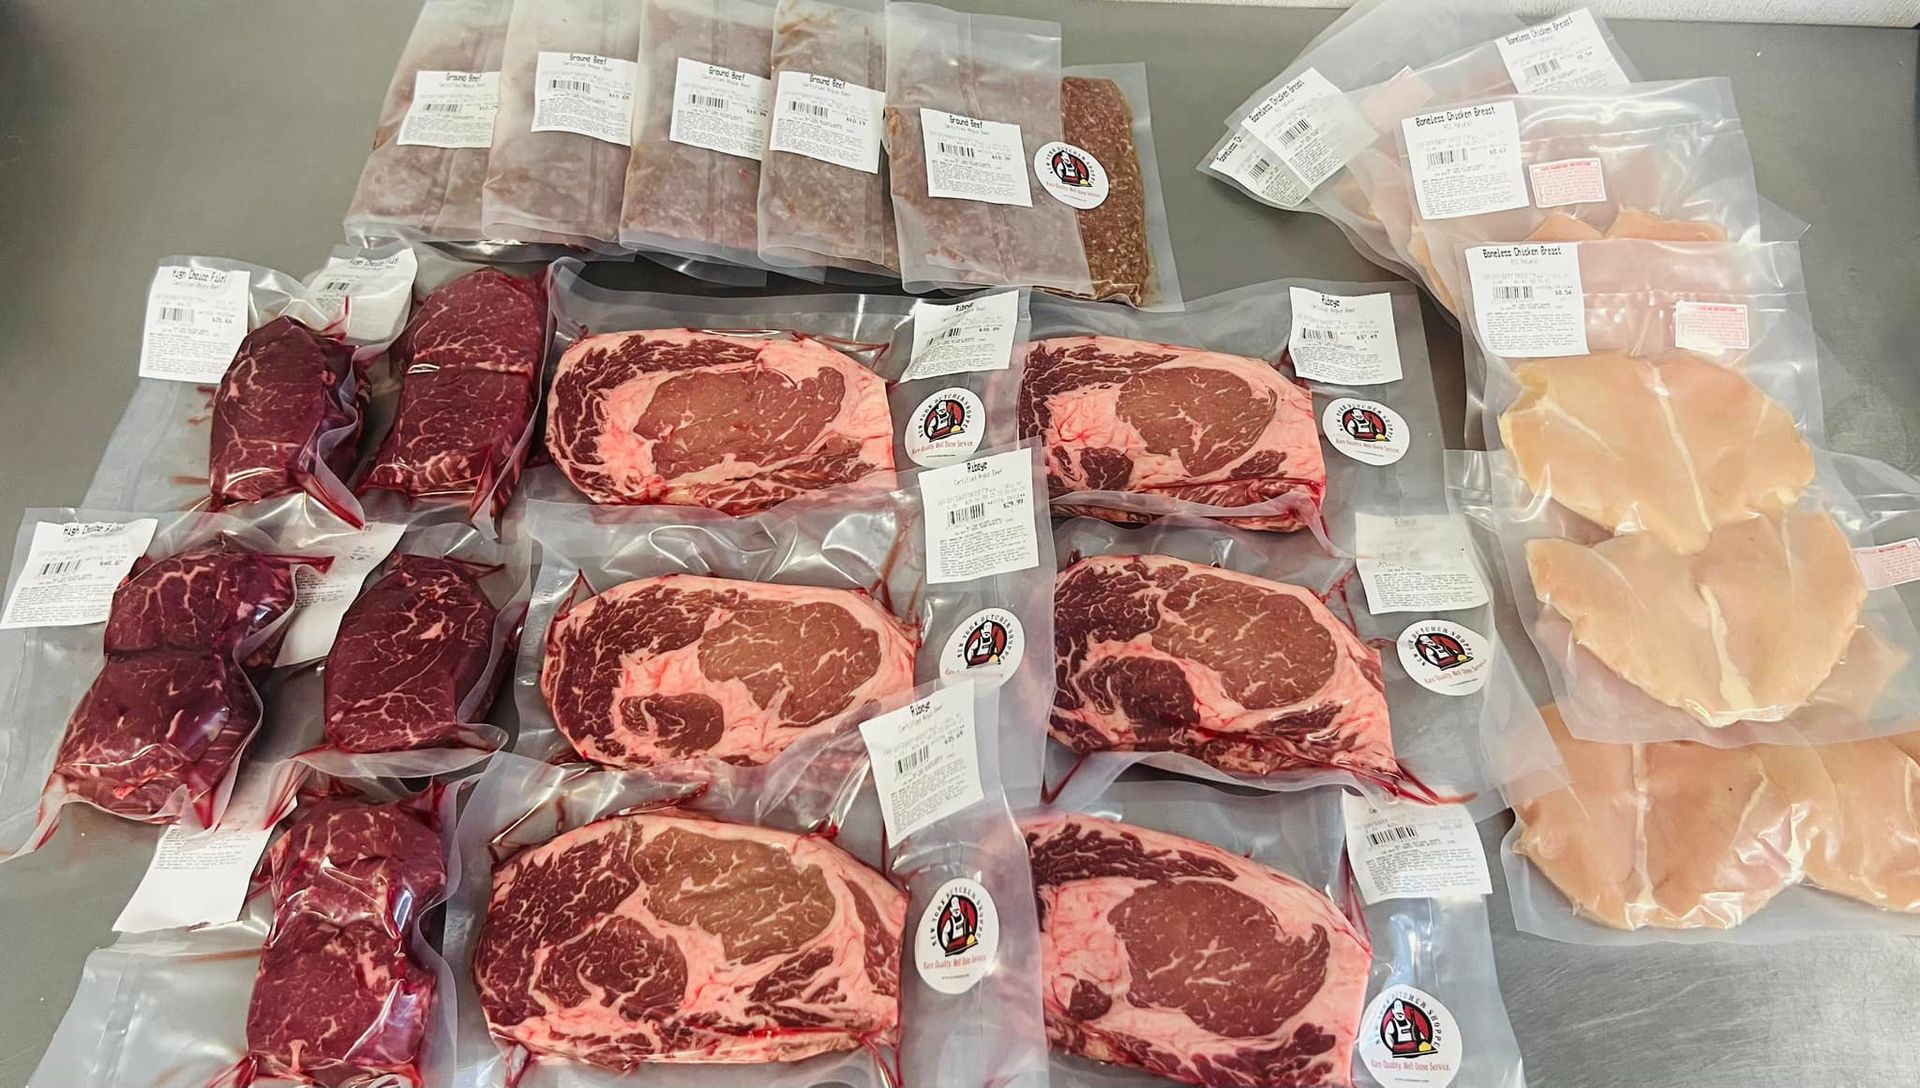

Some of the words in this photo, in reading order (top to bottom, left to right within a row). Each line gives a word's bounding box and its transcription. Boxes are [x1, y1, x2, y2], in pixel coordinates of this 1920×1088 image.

[1505, 33, 1530, 45] Boneless
[1530, 27, 1551, 38] Chicken
[1552, 16, 1573, 31] Breast
[570, 53, 591, 63] Ground
[593, 55, 608, 65] Beef
[709, 66, 730, 78] Ground
[731, 71, 746, 82] Beef
[810, 75, 830, 86] Ground
[832, 78, 846, 89] Beef
[1249, 103, 1273, 123] Boneless
[1269, 90, 1289, 105] Chicken
[1287, 79, 1305, 93] Breast
[950, 114, 969, 126] Ground
[970, 118, 983, 130] Beef
[1415, 114, 1445, 127] Boneless
[1447, 110, 1472, 121] Chicken
[1473, 106, 1495, 117] Breast
[1216, 142, 1238, 163] Boneless
[1482, 248, 1512, 259] Boneless
[1513, 247, 1539, 256] Chicken
[1540, 246, 1562, 256] Breast
[173, 269, 186, 280] High
[188, 269, 209, 281] Choice
[967, 461, 987, 473] Ribeye
[64, 525, 80, 537] High
[910, 701, 931, 716] Ribeye
[1427, 1009, 1442, 1048] SHOPPE
